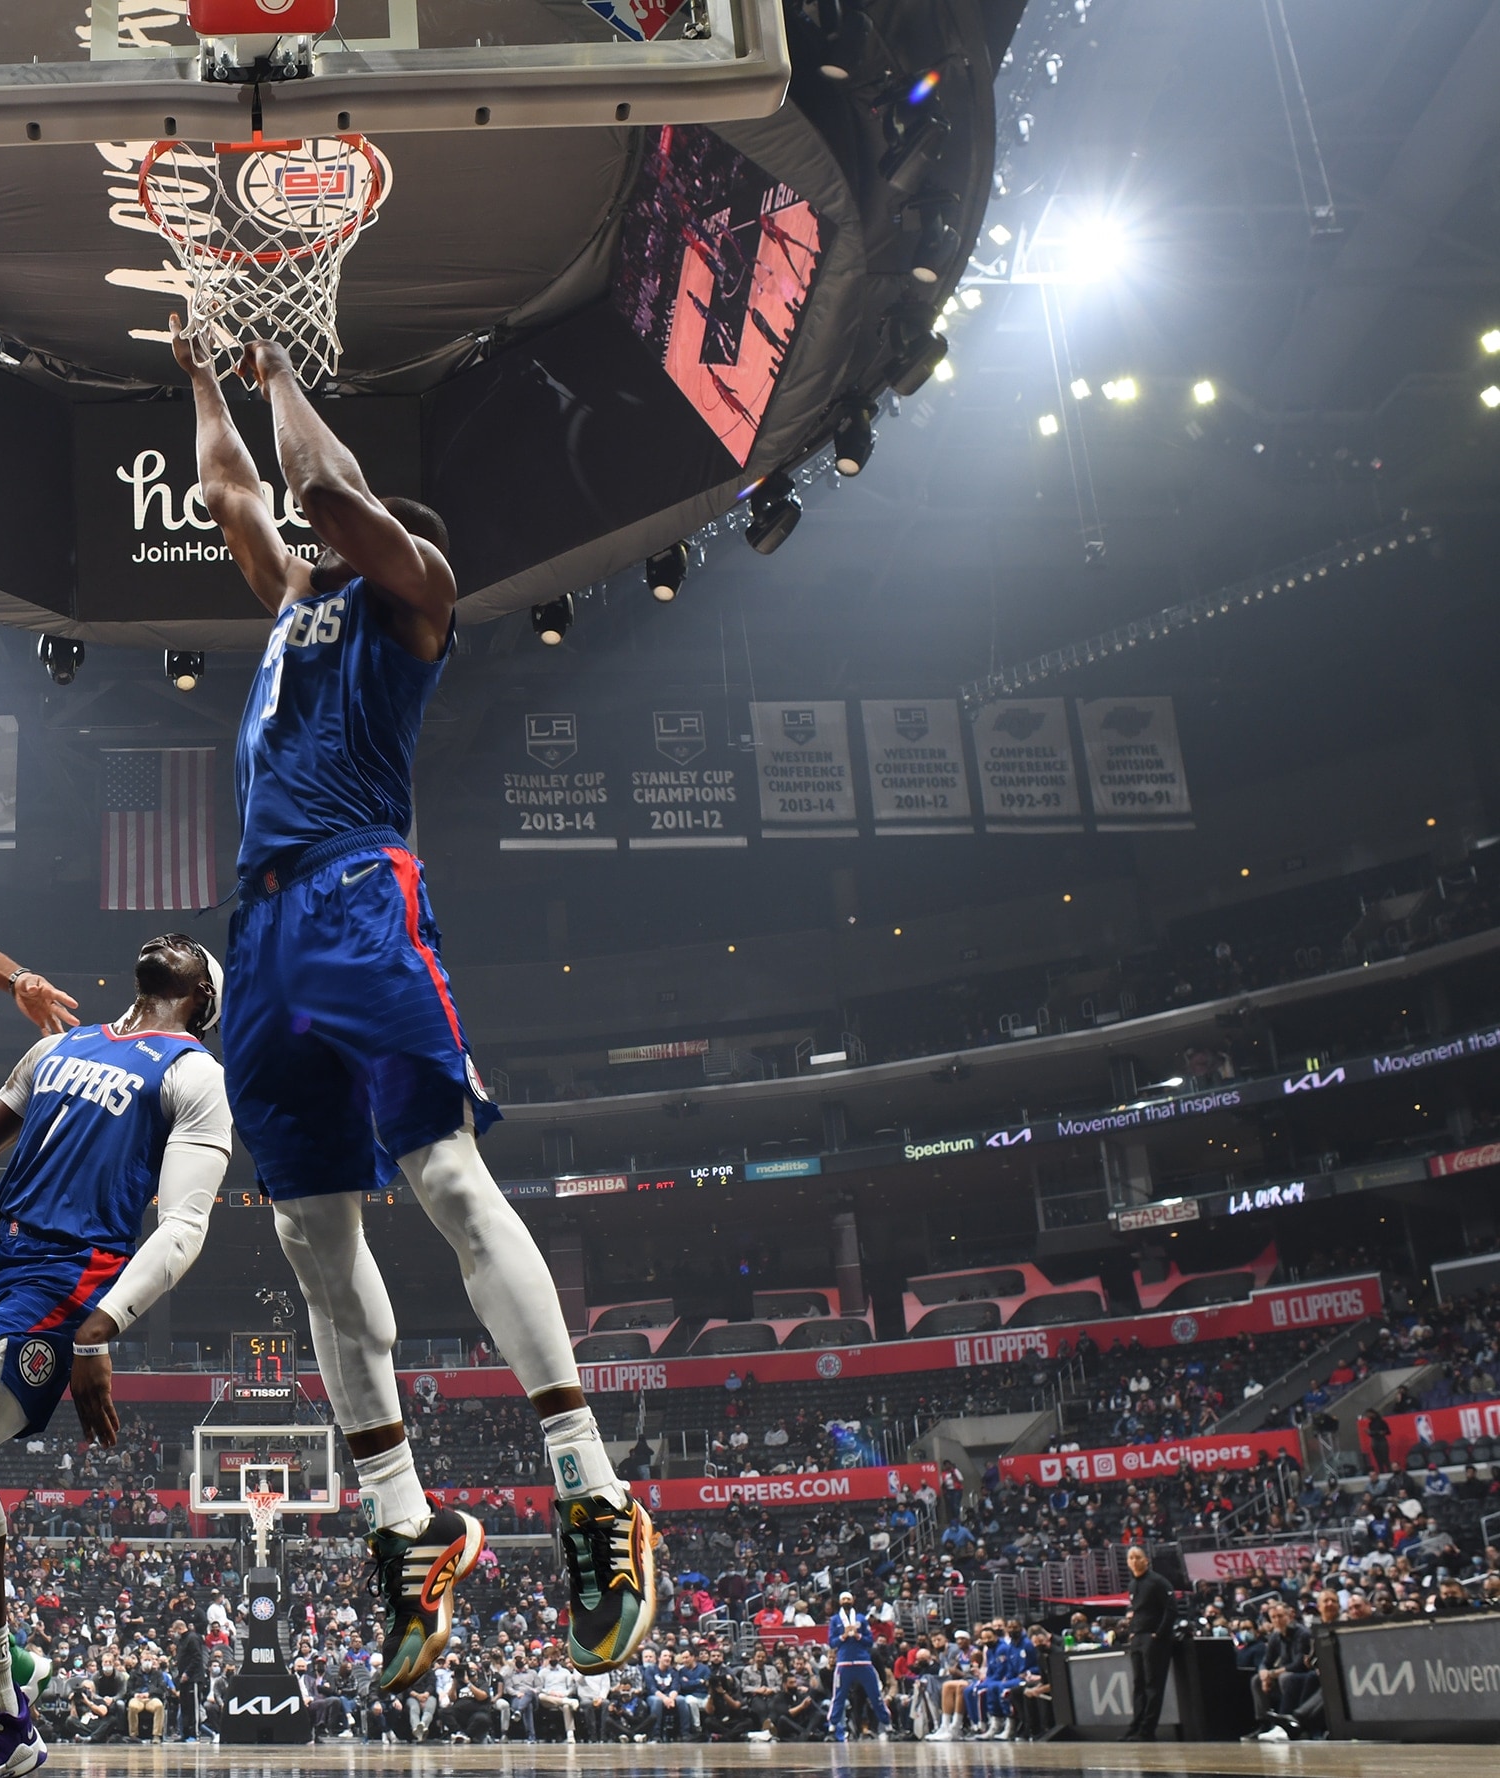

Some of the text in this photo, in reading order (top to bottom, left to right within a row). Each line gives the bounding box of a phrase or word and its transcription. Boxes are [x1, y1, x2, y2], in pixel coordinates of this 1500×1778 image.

[783, 712, 814, 727] LA
[896, 709, 925, 724] LA
[530, 719, 573, 737] LA
[659, 717, 700, 733] LA
[770, 751, 834, 764] WESTERN
[883, 748, 947, 760] WESTERN
[989, 746, 1058, 759] CAMPBELL
[763, 765, 846, 779] CONFERENCE
[875, 761, 960, 775] CONFERENCE
[984, 759, 1070, 774] CONFERENCE
[1105, 758, 1165, 771] DIVISION
[503, 771, 606, 788] STANLEY CUP
[631, 770, 735, 786] STANLEY CUP
[881, 776, 958, 790] CHAMPIONS
[989, 774, 1067, 788] CHAMPIONS
[1099, 772, 1177, 786] CHAMPIONS
[769, 780, 843, 793] CHAMPIONS
[504, 788, 608, 806] CHAMPIONS
[633, 787, 737, 804] CHAMPIONS
[894, 795, 949, 810] 2011-12
[1000, 792, 1062, 808] 1992-93
[1110, 791, 1173, 806] 1990-91
[778, 798, 836, 814] 2013-14
[519, 811, 596, 832] 2013-14
[651, 809, 724, 830] 2011-12
[135, 1039, 164, 1063] honey
[1372, 1038, 1464, 1075] Movement
[33, 1055, 145, 1117] CLIPPERS
[1057, 1109, 1140, 1137] Movement
[1144, 1101, 1176, 1121] that
[1180, 1089, 1241, 1115] inspires
[904, 1137, 974, 1161] Spectrum
[690, 1165, 734, 1178] LAC POR
[755, 1160, 809, 1174] mobilitie
[557, 1178, 626, 1195] TOSHIBA
[697, 1175, 727, 1187] 2 2
[519, 1186, 549, 1194] ULTRA
[387, 1194, 394, 1205] 6
[1120, 1201, 1198, 1231] STAPLES
[1289, 1288, 1365, 1323] CLIPPERS
[250, 1338, 286, 1355] 5:11
[974, 1332, 1049, 1366] CLIPPERS
[257, 1355, 282, 1382] 17
[598, 1363, 668, 1392] CLIPPERS
[251, 1388, 291, 1398] TISSOT
[1122, 1444, 1252, 1473] @LAClippers
[921, 1465, 936, 1473] 116
[699, 1477, 851, 1503] CLIPPERS.COM
[251, 1646, 275, 1664] @NBA
[228, 1695, 300, 1716] KIA
